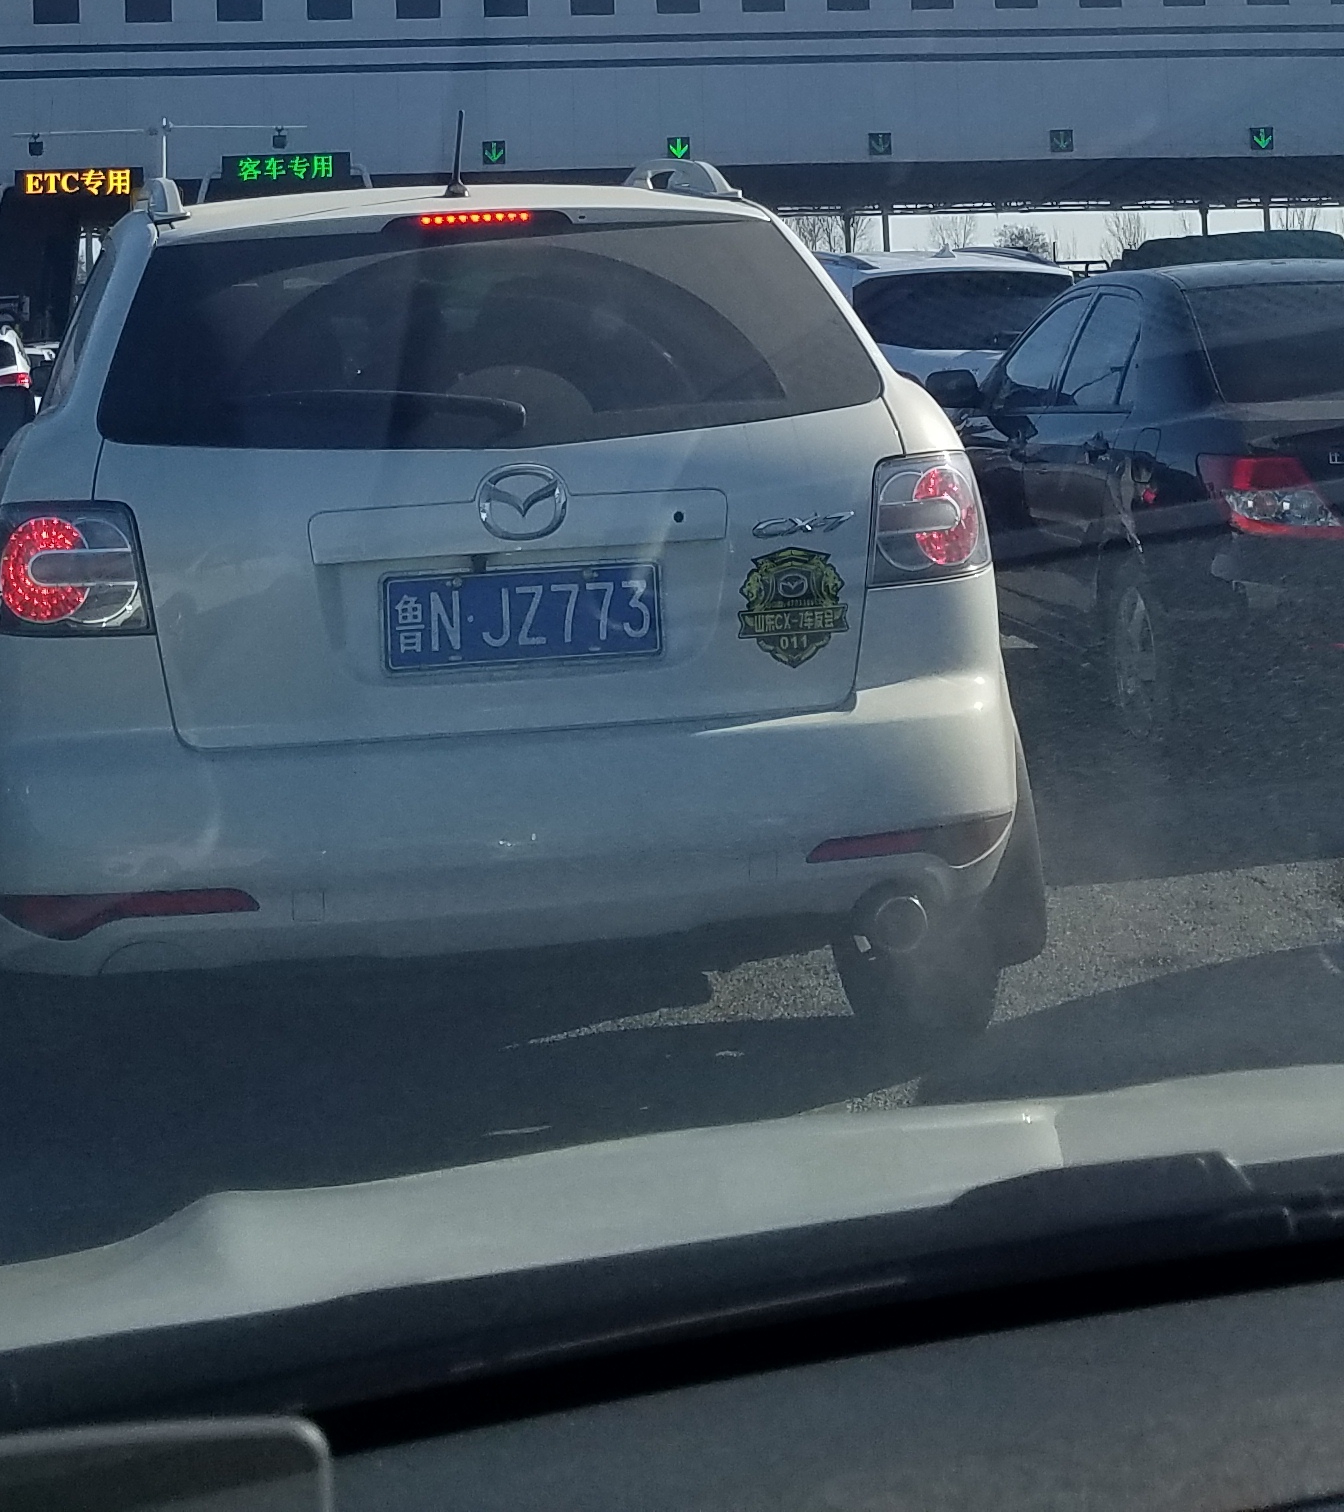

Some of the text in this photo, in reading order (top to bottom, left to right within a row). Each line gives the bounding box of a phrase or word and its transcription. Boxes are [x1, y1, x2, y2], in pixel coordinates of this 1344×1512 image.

[238, 155, 334, 182] 客车专用
[25, 169, 131, 196] ETC专用
[752, 511, 854, 538] CX-7
[780, 636, 807, 650] 011
